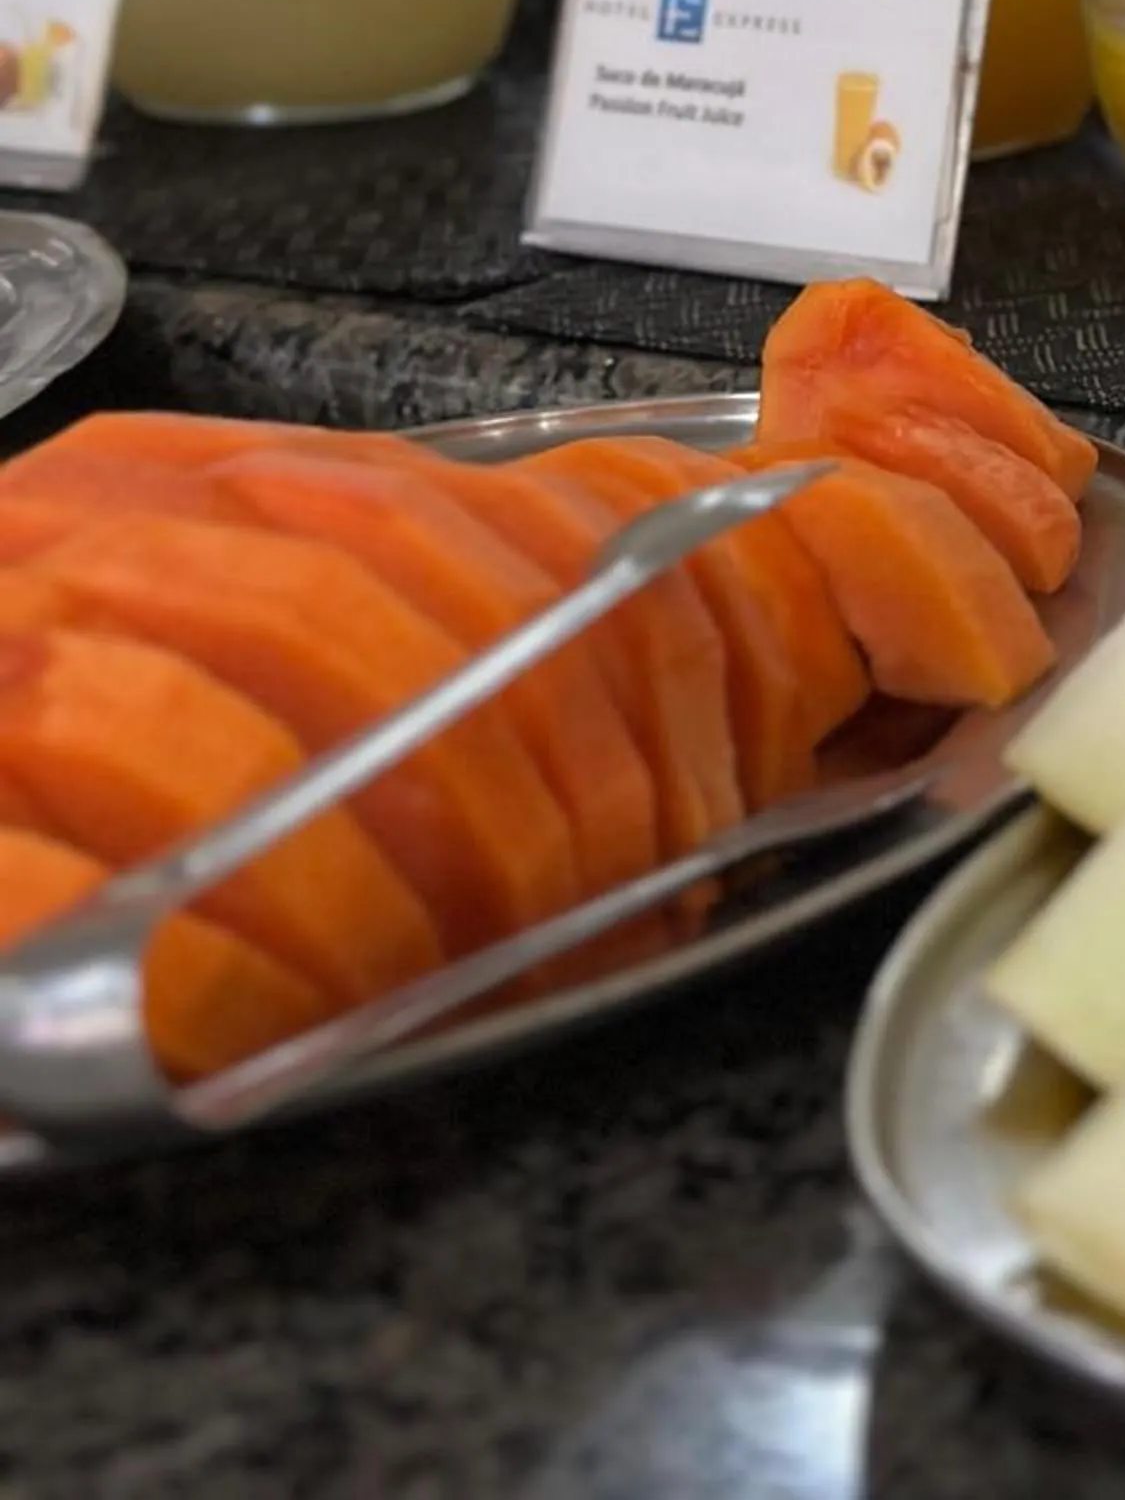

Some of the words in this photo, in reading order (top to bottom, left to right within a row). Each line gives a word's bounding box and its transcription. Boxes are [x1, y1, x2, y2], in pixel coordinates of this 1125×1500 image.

[595, 64, 636, 88] Suco
[641, 69, 661, 90] de
[589, 93, 653, 116] Passion
[657, 100, 697, 123] Fruit
[700, 107, 744, 128] Juice
